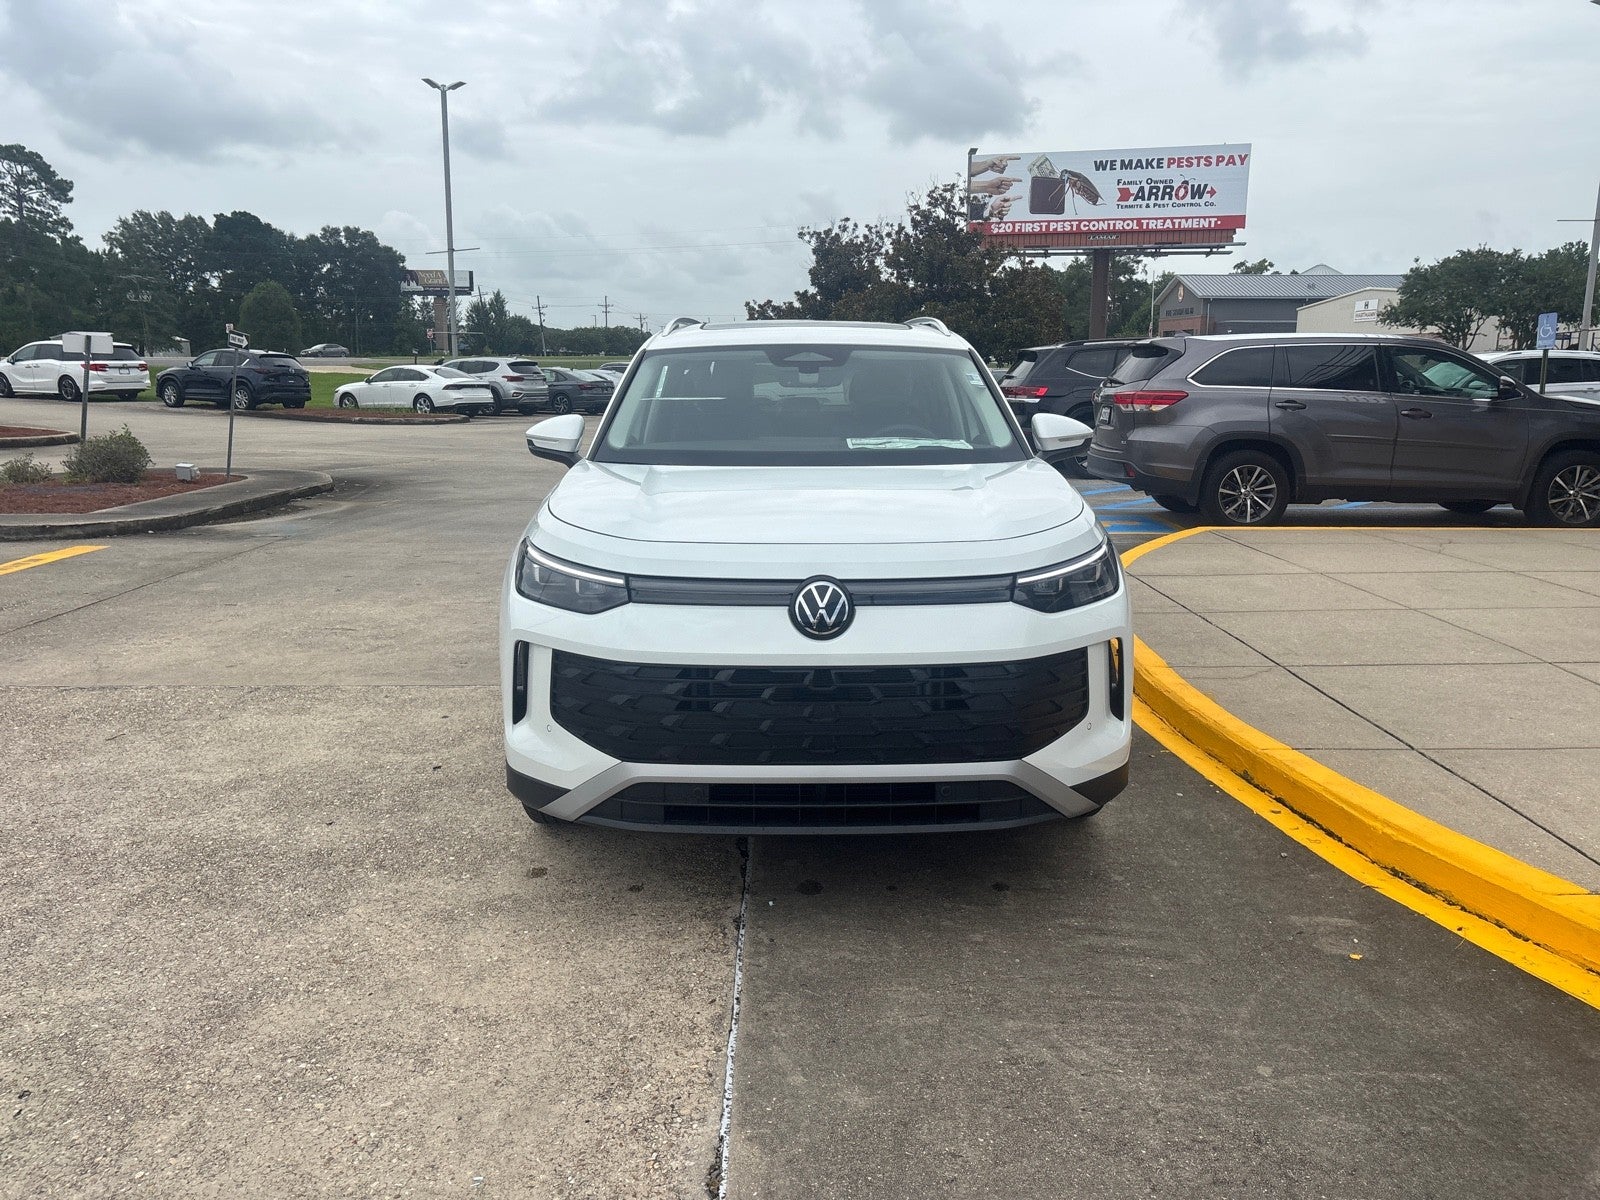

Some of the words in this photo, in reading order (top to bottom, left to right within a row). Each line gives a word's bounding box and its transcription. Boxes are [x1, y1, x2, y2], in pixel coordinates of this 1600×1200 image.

[1094, 159, 1117, 171] WE
[1120, 157, 1164, 170] MAKE
[1167, 155, 1213, 169] PESTS
[1215, 154, 1248, 167] PAY
[1117, 178, 1143, 186] FAMILY
[1145, 177, 1174, 186] OWNED
[1133, 183, 1209, 202] ARROW
[990, 223, 1013, 235] $20
[1014, 222, 1048, 233] FIRST
[1049, 221, 1079, 232] PEST
[1079, 219, 1139, 231] CONTROL
